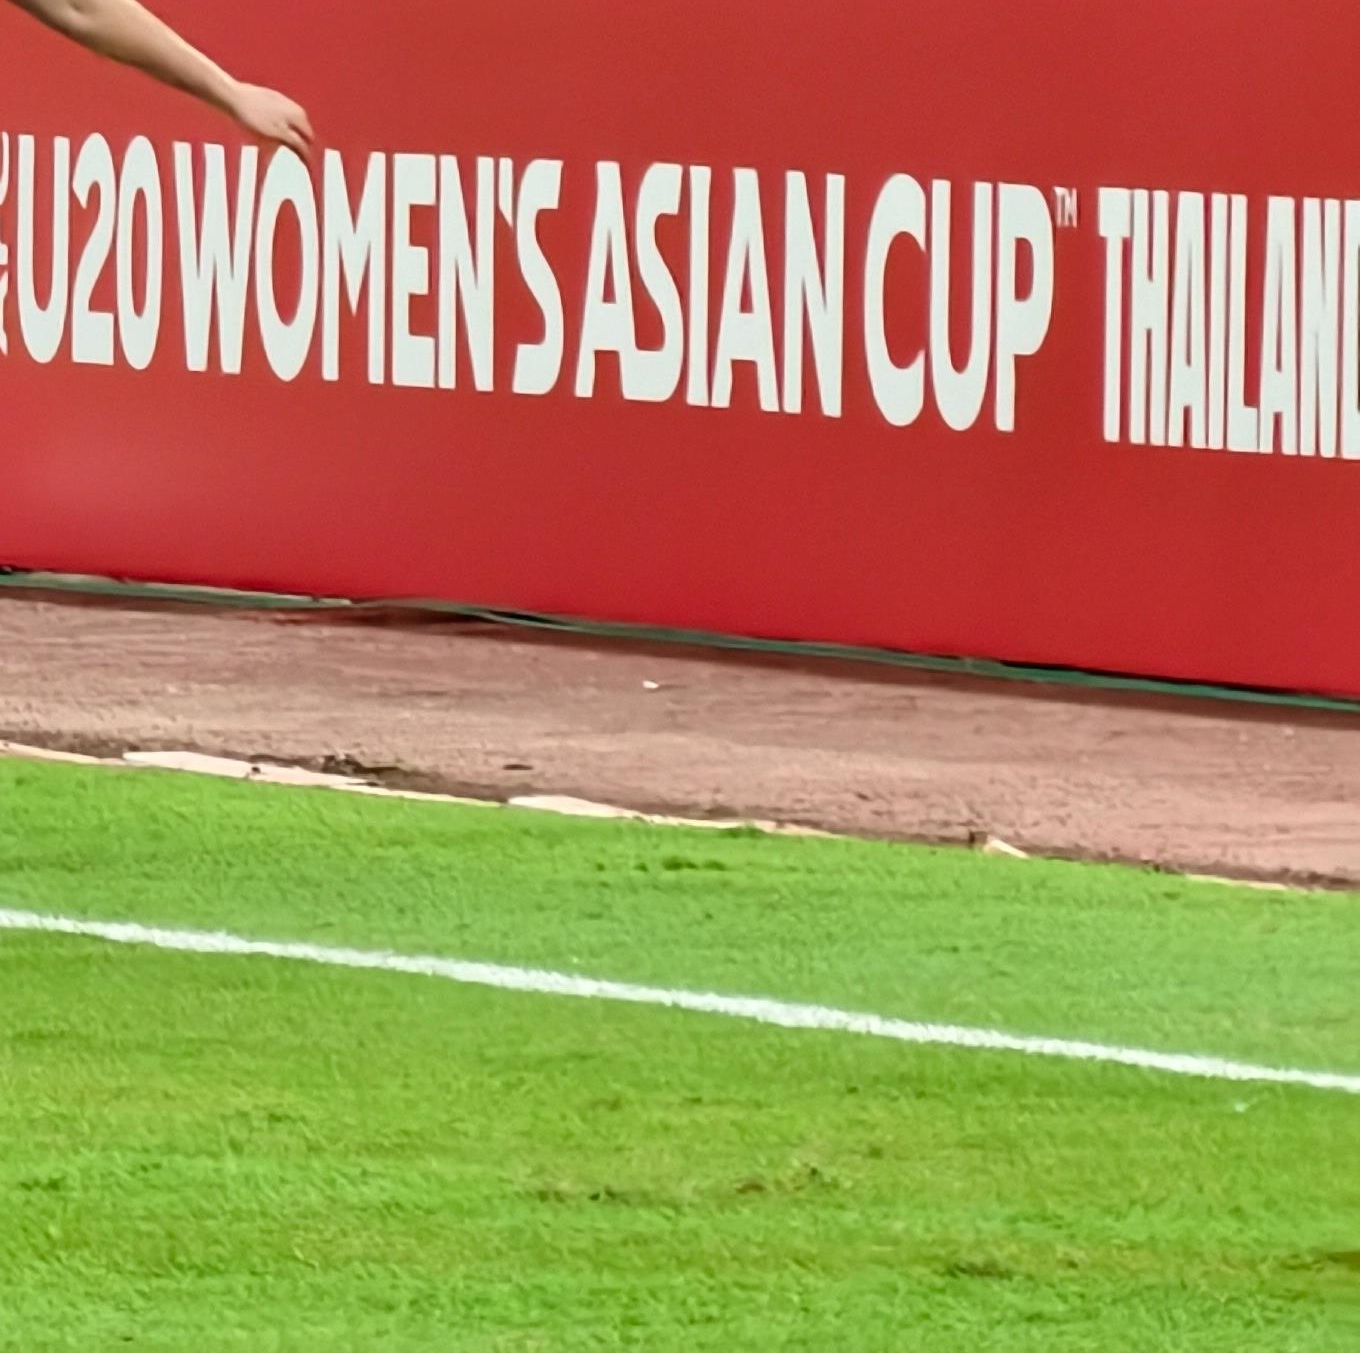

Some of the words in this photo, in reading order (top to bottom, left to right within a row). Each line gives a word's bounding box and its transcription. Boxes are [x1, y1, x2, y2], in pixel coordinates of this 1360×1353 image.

[16, 131, 164, 371] U20
[171, 140, 566, 395] WOMEN'S
[573, 160, 847, 418] ASIAN
